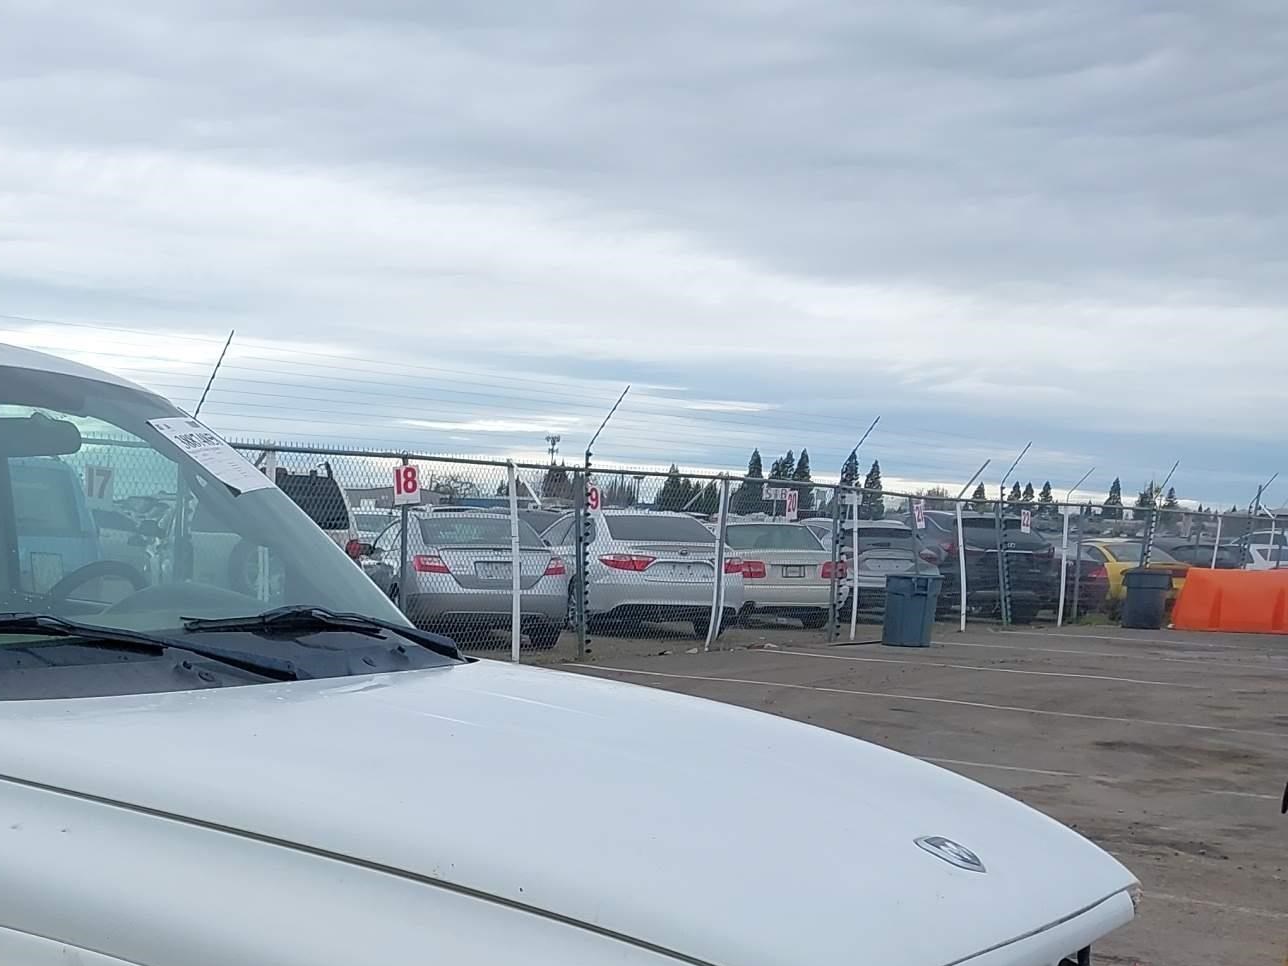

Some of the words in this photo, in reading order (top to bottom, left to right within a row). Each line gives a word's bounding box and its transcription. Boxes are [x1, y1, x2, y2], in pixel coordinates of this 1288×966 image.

[87, 467, 112, 498] 17
[395, 467, 417, 494] 18
[590, 487, 599, 509] 9
[787, 493, 797, 512] 20
